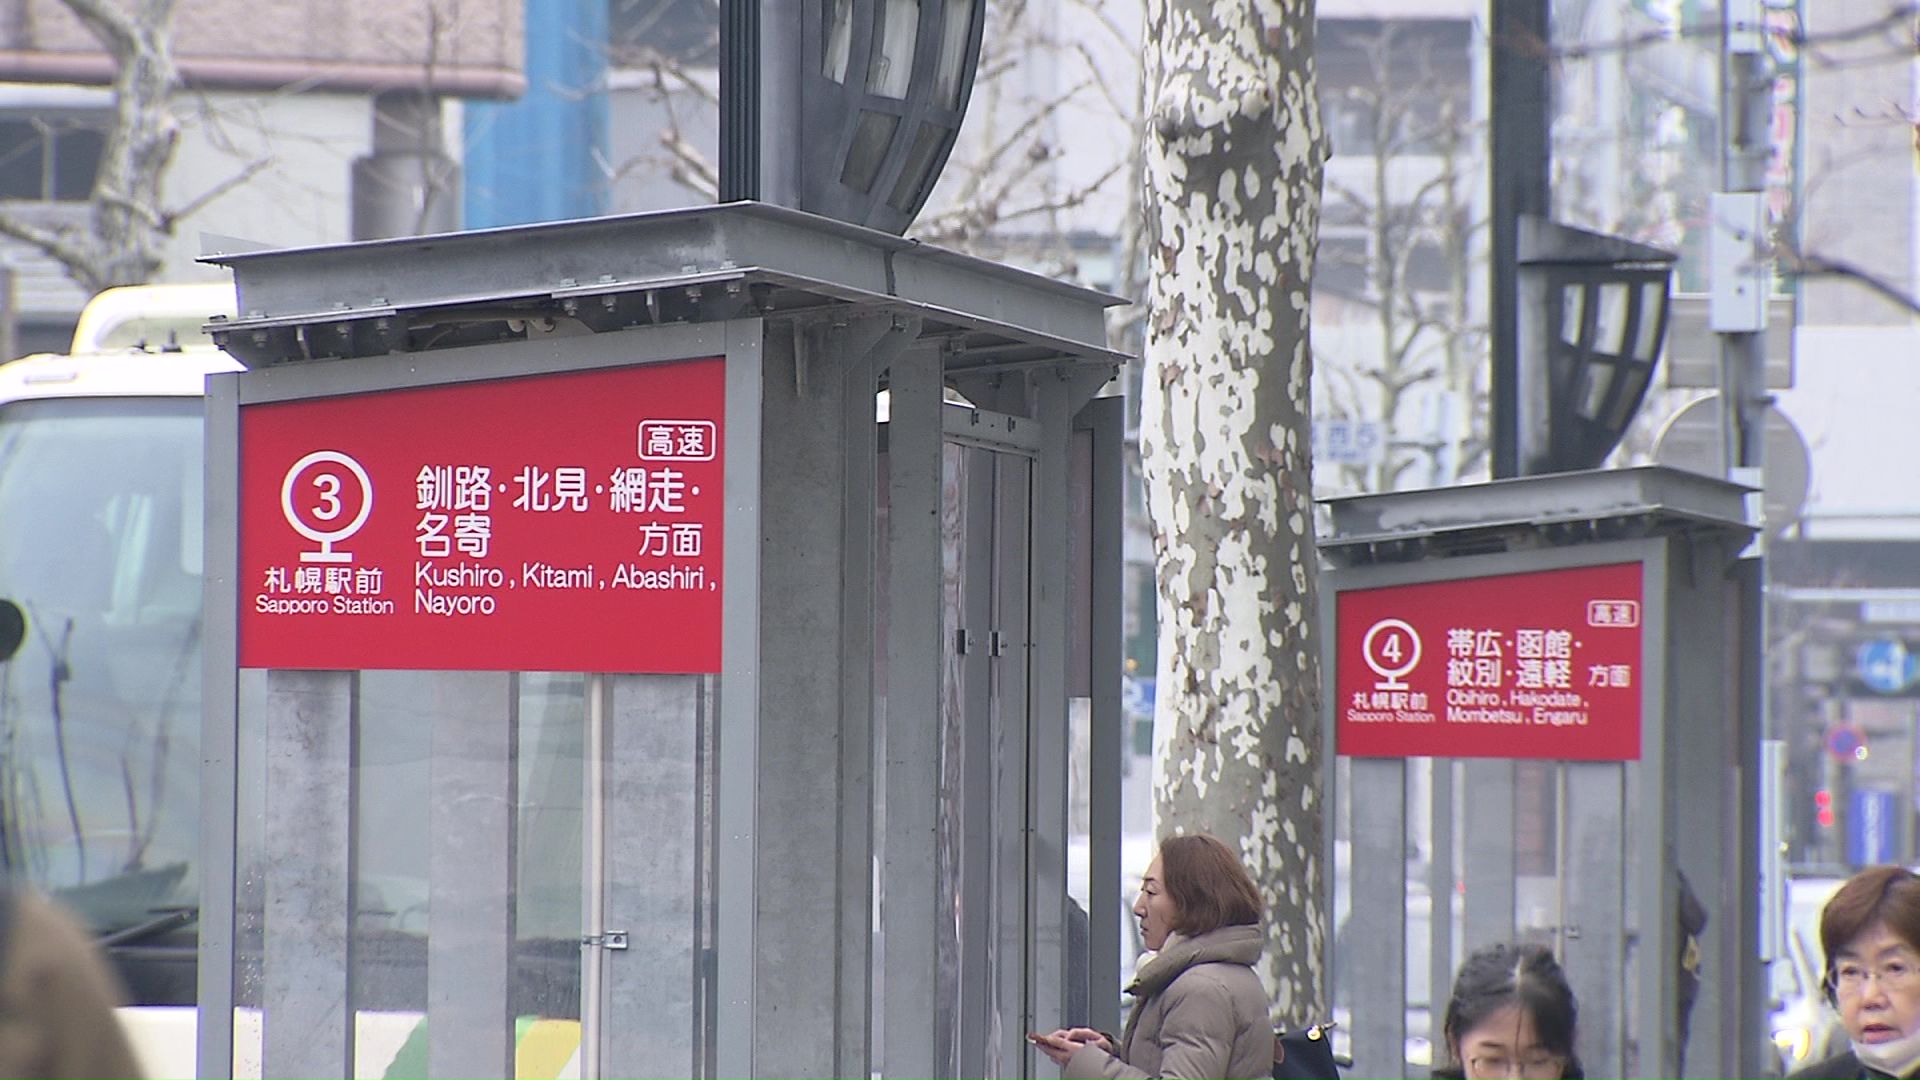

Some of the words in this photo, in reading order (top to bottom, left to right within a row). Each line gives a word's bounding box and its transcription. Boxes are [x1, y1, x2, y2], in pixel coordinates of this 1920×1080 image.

[647, 425, 706, 455] 高速
[311, 474, 341, 521] 3
[415, 513, 492, 558] 名寄
[638, 522, 703, 557] 方面
[264, 567, 383, 595] 札幌駅前
[256, 594, 329, 615] Sapporo
[332, 595, 394, 615] Station
[415, 590, 496, 617] Nayoro
[1381, 633, 1402, 663] 4
[1588, 664, 1631, 688] 方面
[1352, 691, 1428, 710] 札幌駅前
[1347, 709, 1395, 724] Sapporo
[1396, 709, 1436, 724] Station
[1533, 707, 1589, 727] Engaru
